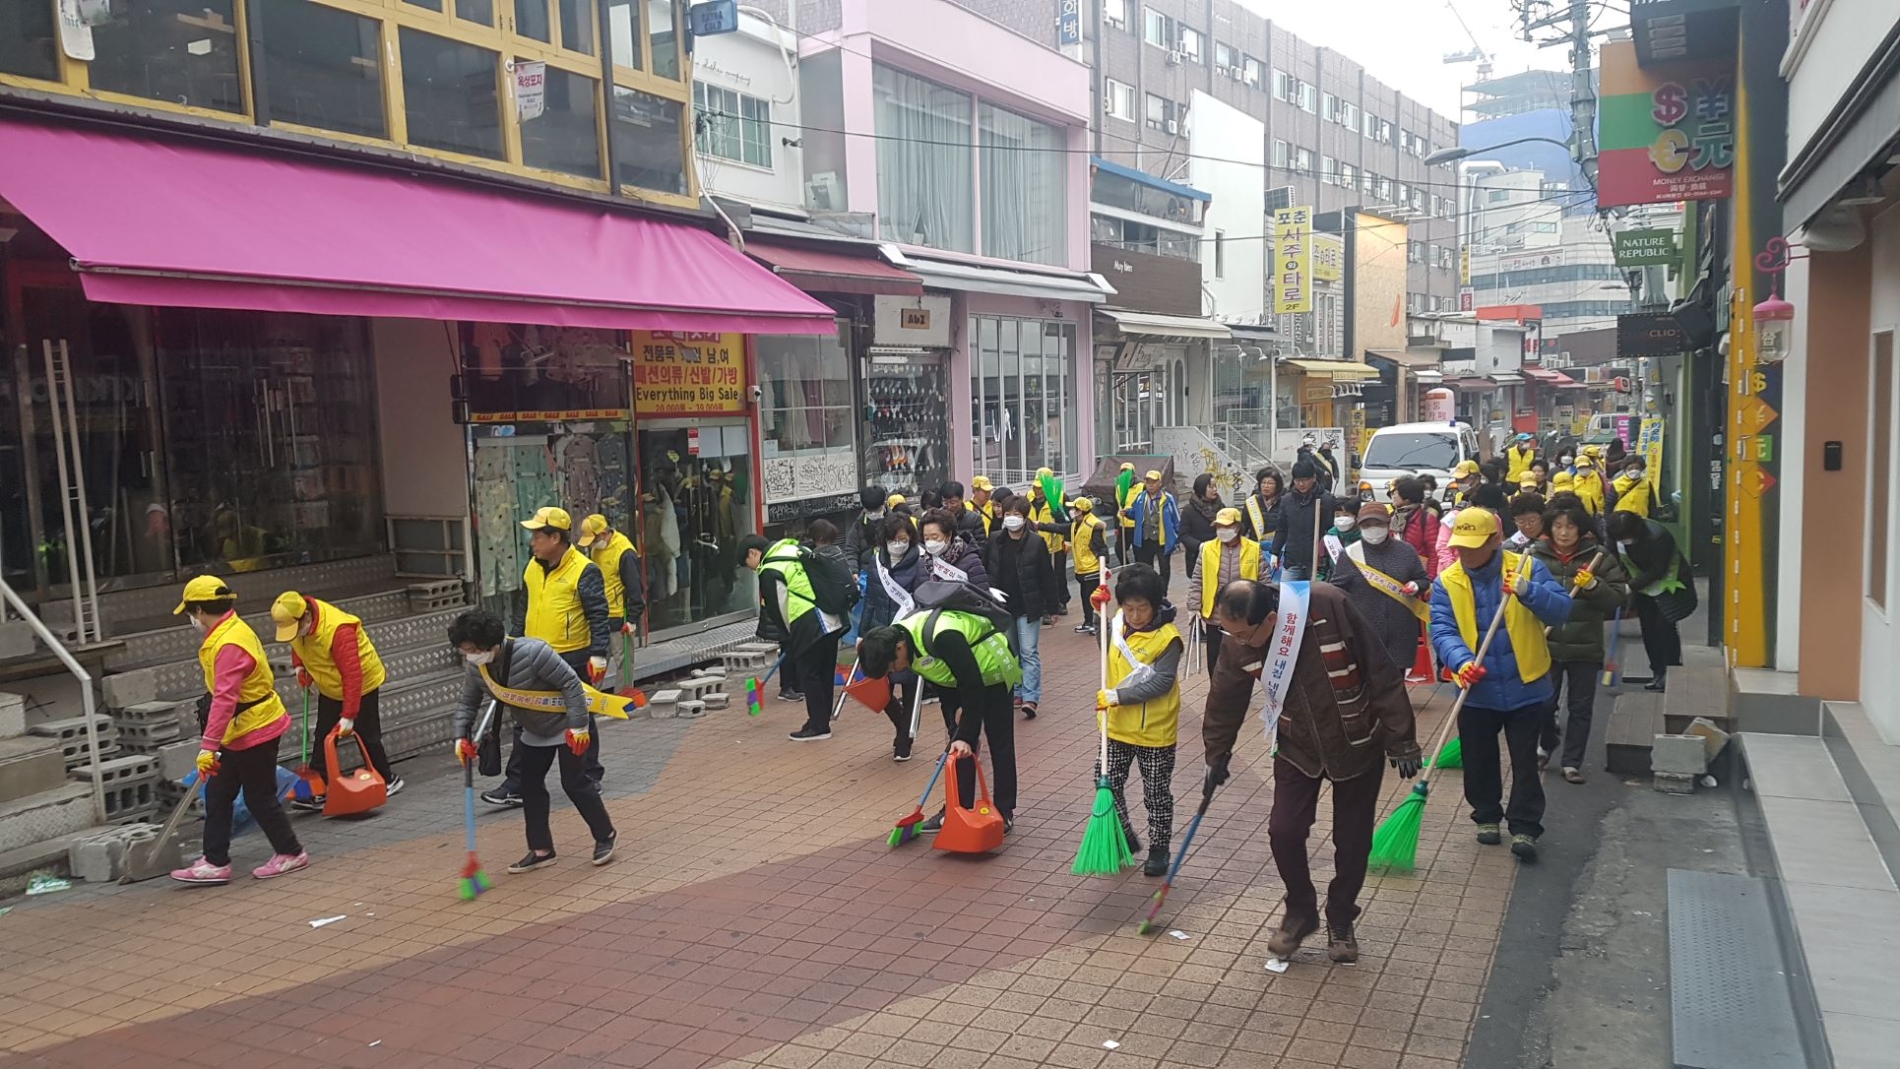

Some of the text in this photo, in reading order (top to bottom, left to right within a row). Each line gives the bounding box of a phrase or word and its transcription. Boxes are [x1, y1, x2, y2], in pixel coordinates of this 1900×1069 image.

[1651, 82, 1688, 127] $
[1689, 122, 1732, 171] 元
[1279, 210, 1307, 225] 포춘
[1622, 236, 1666, 247] NATURE
[1619, 247, 1669, 258] REPUBLIC
[1282, 227, 1302, 302] 사주와타로
[1649, 329, 1676, 337] CLIO
[643, 344, 676, 362] 전품목
[636, 386, 739, 402] Everything Big Sale
[1277, 612, 1299, 657] 함께해요
